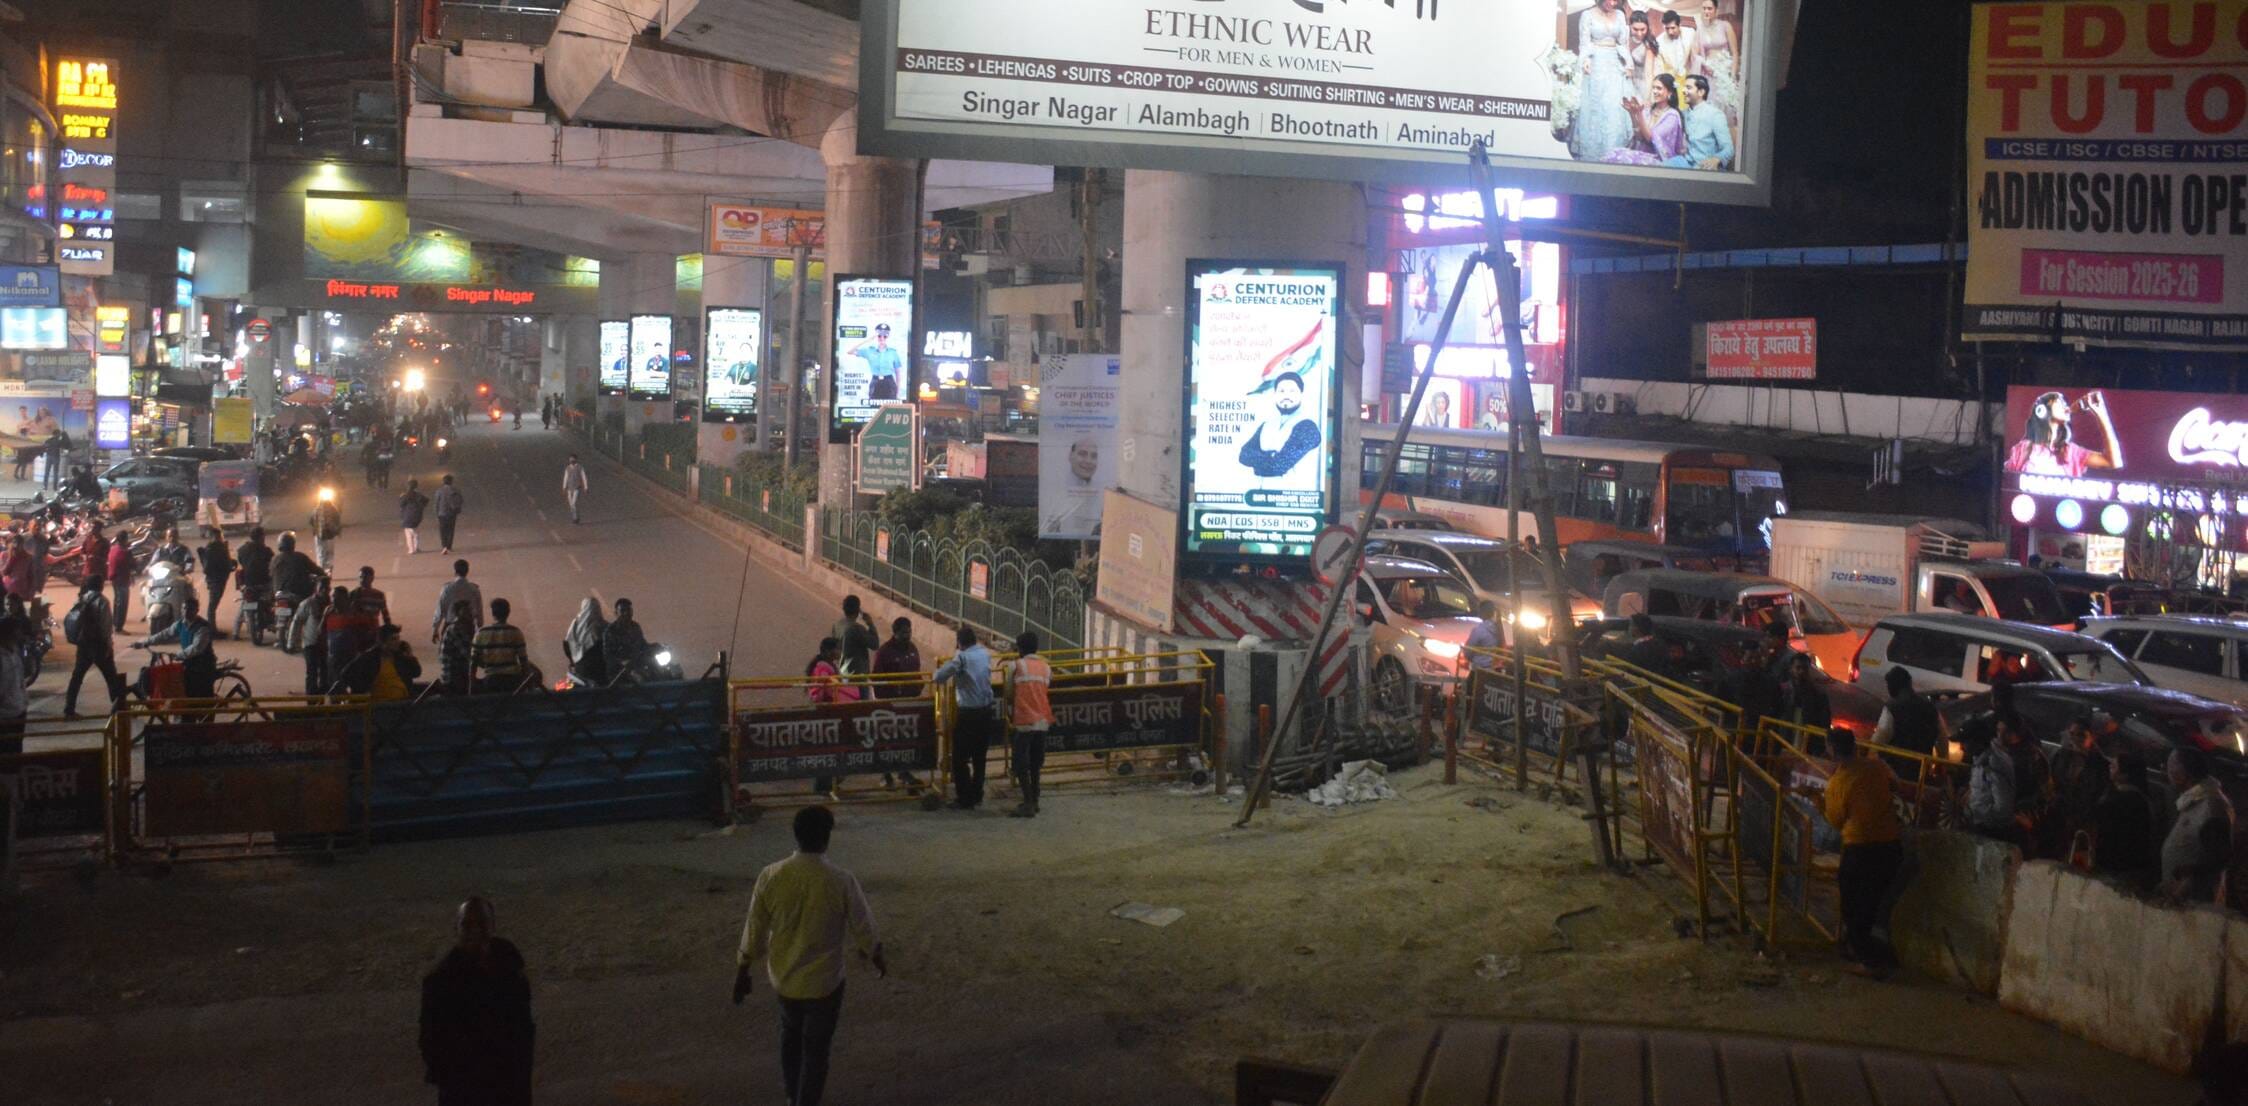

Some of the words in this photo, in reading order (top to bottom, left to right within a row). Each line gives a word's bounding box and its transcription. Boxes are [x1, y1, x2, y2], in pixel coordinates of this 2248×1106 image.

[1144, 8, 1273, 47] ETHNIC
[1282, 21, 1375, 55] WEAR
[1987, 3, 2248, 59] EDU
[1178, 46, 1203, 64] FOR
[1216, 51, 1255, 67] MEN
[1258, 55, 1272, 68] &
[1278, 55, 1343, 73] WOMEN
[904, 53, 965, 73] SAREES
[977, 59, 1056, 79] LEHENGAS
[1166, 74, 1194, 90] TOP
[1325, 87, 1385, 105] SHIRTING
[1438, 96, 1474, 112] WEAR
[962, 90, 1040, 120] Singar
[1048, 96, 1117, 125] Nagar
[1138, 104, 1250, 135] Alambagh
[1270, 113, 1378, 141] Bhootnath
[2002, 143, 2049, 157] ICSE
[2065, 143, 2098, 158] ISC
[2116, 144, 2174, 159] CBSE
[1981, 172, 2172, 234] ADMISSION
[2039, 258, 2063, 292] For
[2067, 258, 2128, 295] Session
[2132, 262, 2198, 298] 2025-26
[370, 283, 400, 298] नगर
[447, 287, 491, 304] Singar
[493, 289, 534, 305] Nagar
[858, 286, 907, 294] CENTURION
[1235, 283, 1326, 296] CENTURION
[1235, 295, 1277, 305] DEFENCE
[1280, 296, 1325, 306] ACADEMY
[2123, 315, 2162, 334] GOMTI
[2164, 317, 2203, 336] NAGAR
[1711, 332, 1741, 355] किराये
[1744, 332, 1760, 361] हेतु
[1763, 335, 1800, 355] उपलब्ध
[1803, 329, 1812, 354] है
[1055, 391, 1077, 399] CHIEF
[1079, 392, 1115, 400] JUSTICES
[1209, 401, 1247, 411] HIGHEST
[885, 413, 910, 425] PWD
[1209, 412, 1256, 422] SELECTION
[1208, 424, 1229, 433] RATE
[1231, 424, 1241, 433] IN
[1208, 436, 1233, 445] INDIA
[1206, 517, 1227, 526] NDA
[1235, 517, 1254, 526] CDS
[1261, 518, 1280, 527] SSB
[1287, 519, 1309, 529] MNS
[1122, 692, 1184, 730] पुलिस
[748, 717, 842, 749] यातायात
[852, 708, 920, 749] पुलिस
[750, 758, 788, 773] जनपद
[796, 754, 839, 770] लखनऊ
[847, 751, 875, 767] अवध
